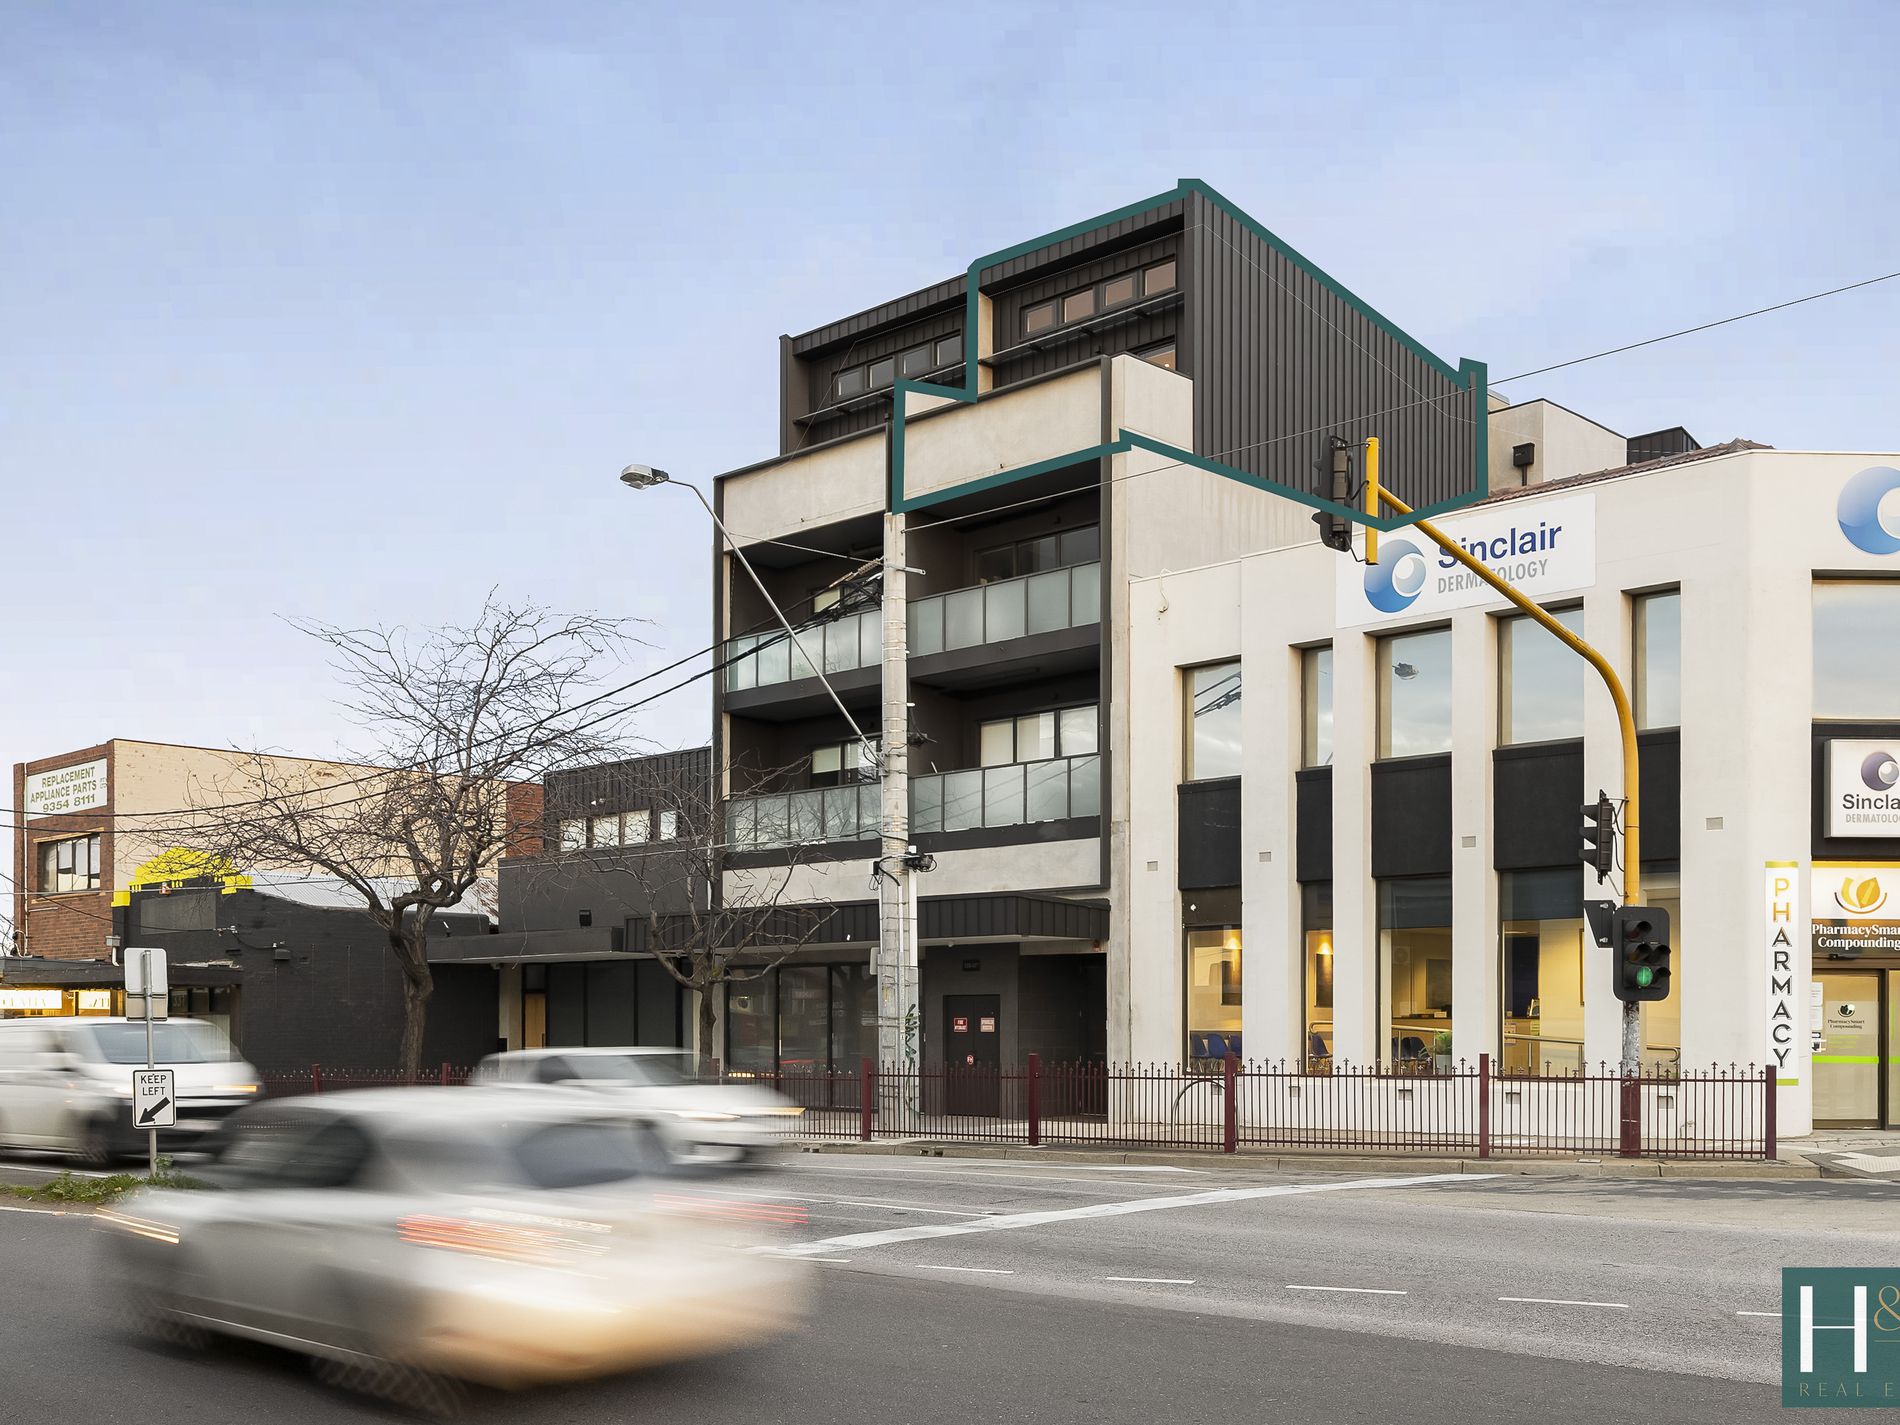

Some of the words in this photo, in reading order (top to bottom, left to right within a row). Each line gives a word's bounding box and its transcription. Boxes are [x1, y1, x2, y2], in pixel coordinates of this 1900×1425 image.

[1438, 558, 1549, 594] DERMOLOGY
[41, 766, 96, 788] REPLACEMENT
[30, 785, 71, 803] APPLIANCE
[72, 779, 97, 795] PARTS
[42, 799, 70, 813] 9354
[73, 793, 96, 807] 8111
[1845, 813, 1900, 824] DERMATOLO
[1772, 877, 1793, 1070] PHARMACY
[140, 1074, 167, 1085] KEEP
[142, 1086, 166, 1096] LEFT
